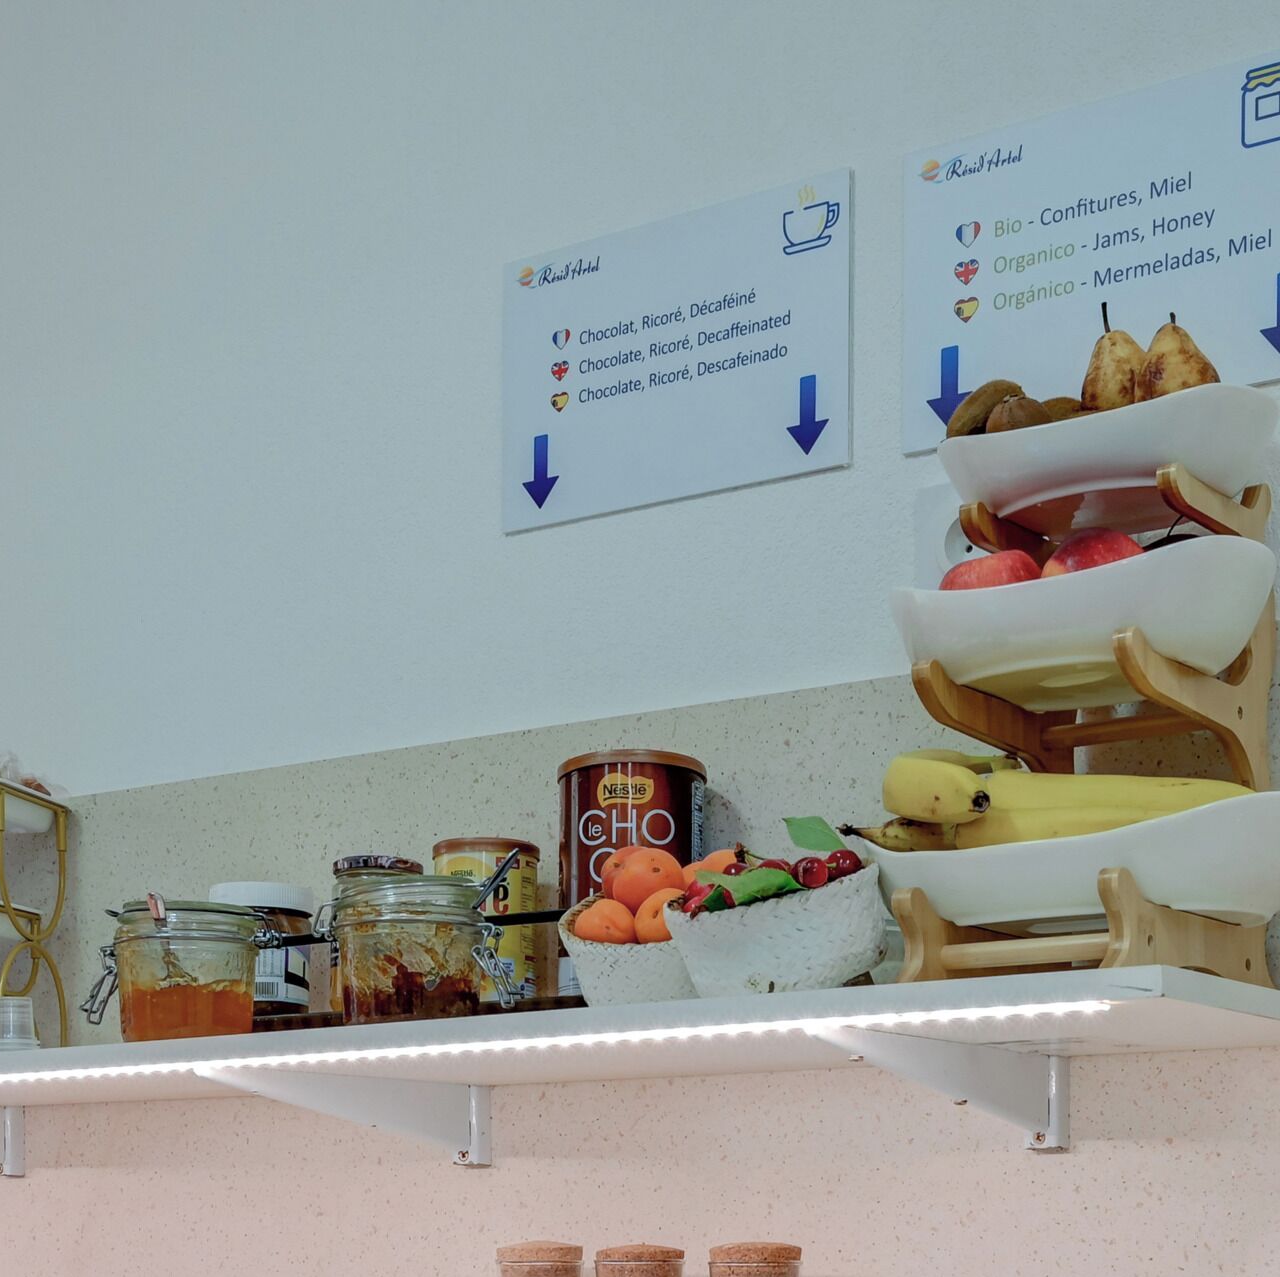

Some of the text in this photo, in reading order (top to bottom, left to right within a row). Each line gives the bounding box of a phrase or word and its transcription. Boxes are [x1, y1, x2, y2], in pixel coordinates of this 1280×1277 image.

[993, 214, 1022, 238] Bio
[1040, 186, 1143, 228] Confitures,
[1149, 171, 1193, 201] Miel
[992, 277, 1075, 313] Orgánico
[1093, 247, 1221, 289] Mermeladas,
[1228, 229, 1272, 259] Miel
[993, 240, 1075, 276] Organico
[1092, 223, 1145, 252] Jams,
[1152, 208, 1216, 240] Honey
[579, 288, 756, 345] Chocolat, Ricoré, Décaféiné
[579, 310, 791, 375] Chocolate, Ricoré, Decaffeinated
[578, 343, 788, 404] Chocolate, Ricoré, Descafeinado
[578, 808, 676, 846] CHO
